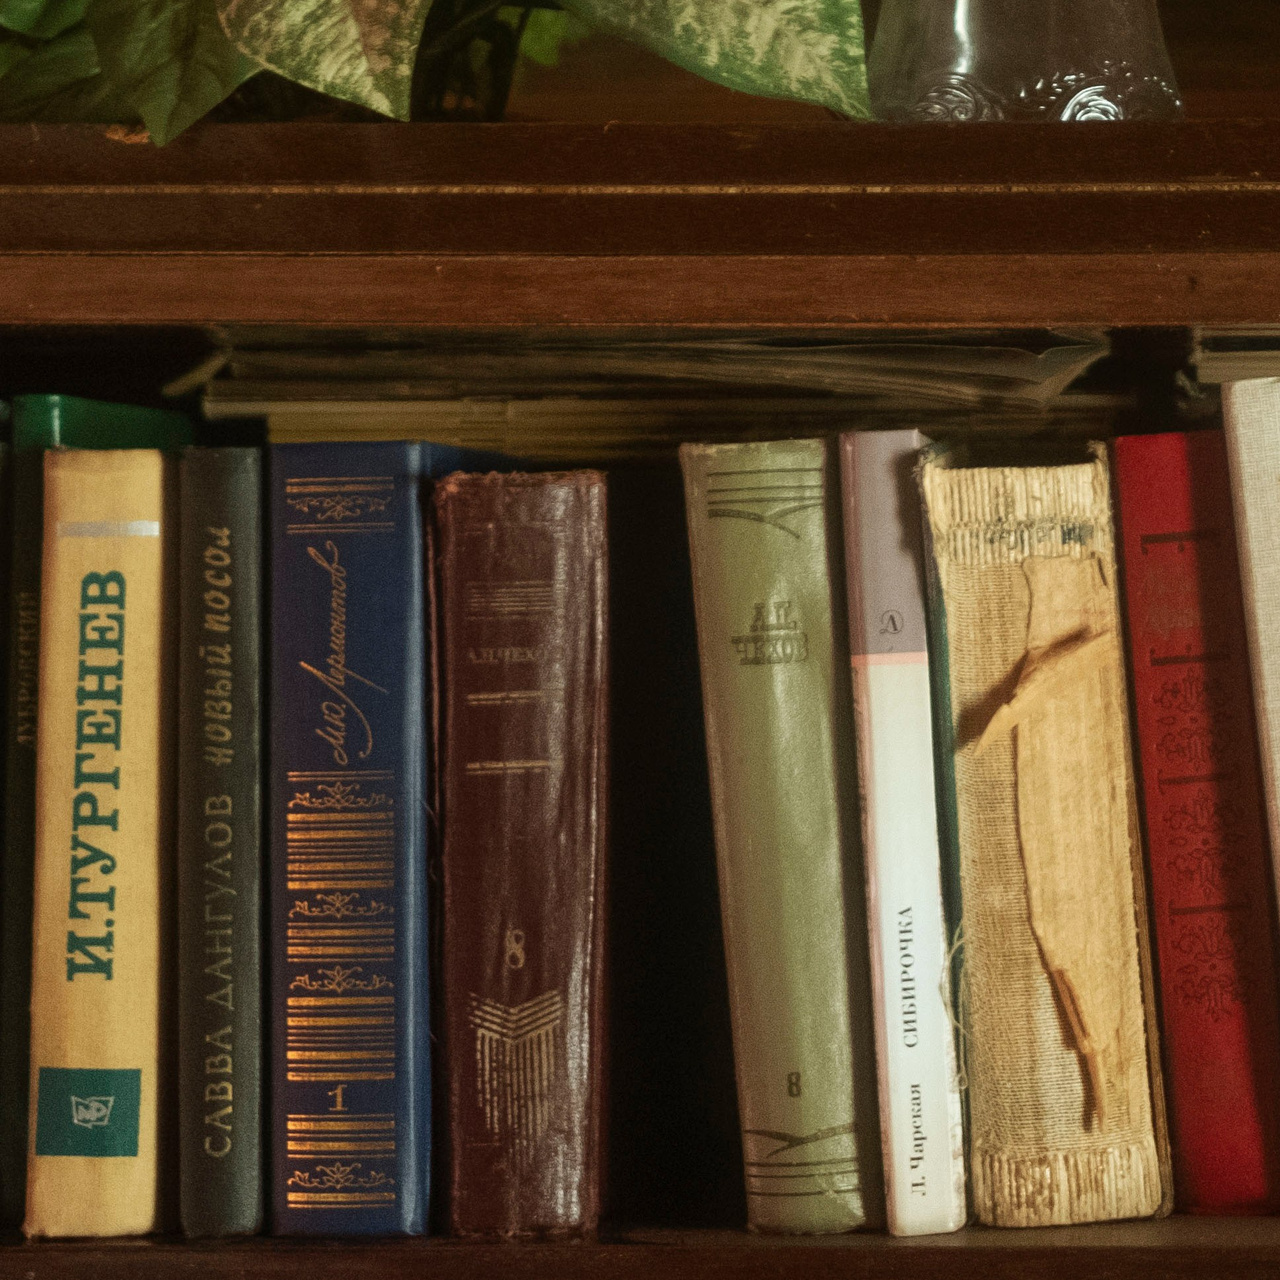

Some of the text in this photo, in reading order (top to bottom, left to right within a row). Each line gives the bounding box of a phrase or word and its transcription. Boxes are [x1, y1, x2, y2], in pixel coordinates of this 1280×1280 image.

[299, 540, 390, 759] Лермонтов
[730, 631, 809, 666] ЧЕХОВ
[203, 793, 237, 1011] ДАНГУЛОВ
[504, 928, 526, 970] 8
[203, 1024, 234, 1159] САВВА
[787, 1071, 802, 1099] 8
[898, 906, 928, 1197] Л. Чарская СИБИРОЧКА
[327, 1084, 349, 1111] 1
